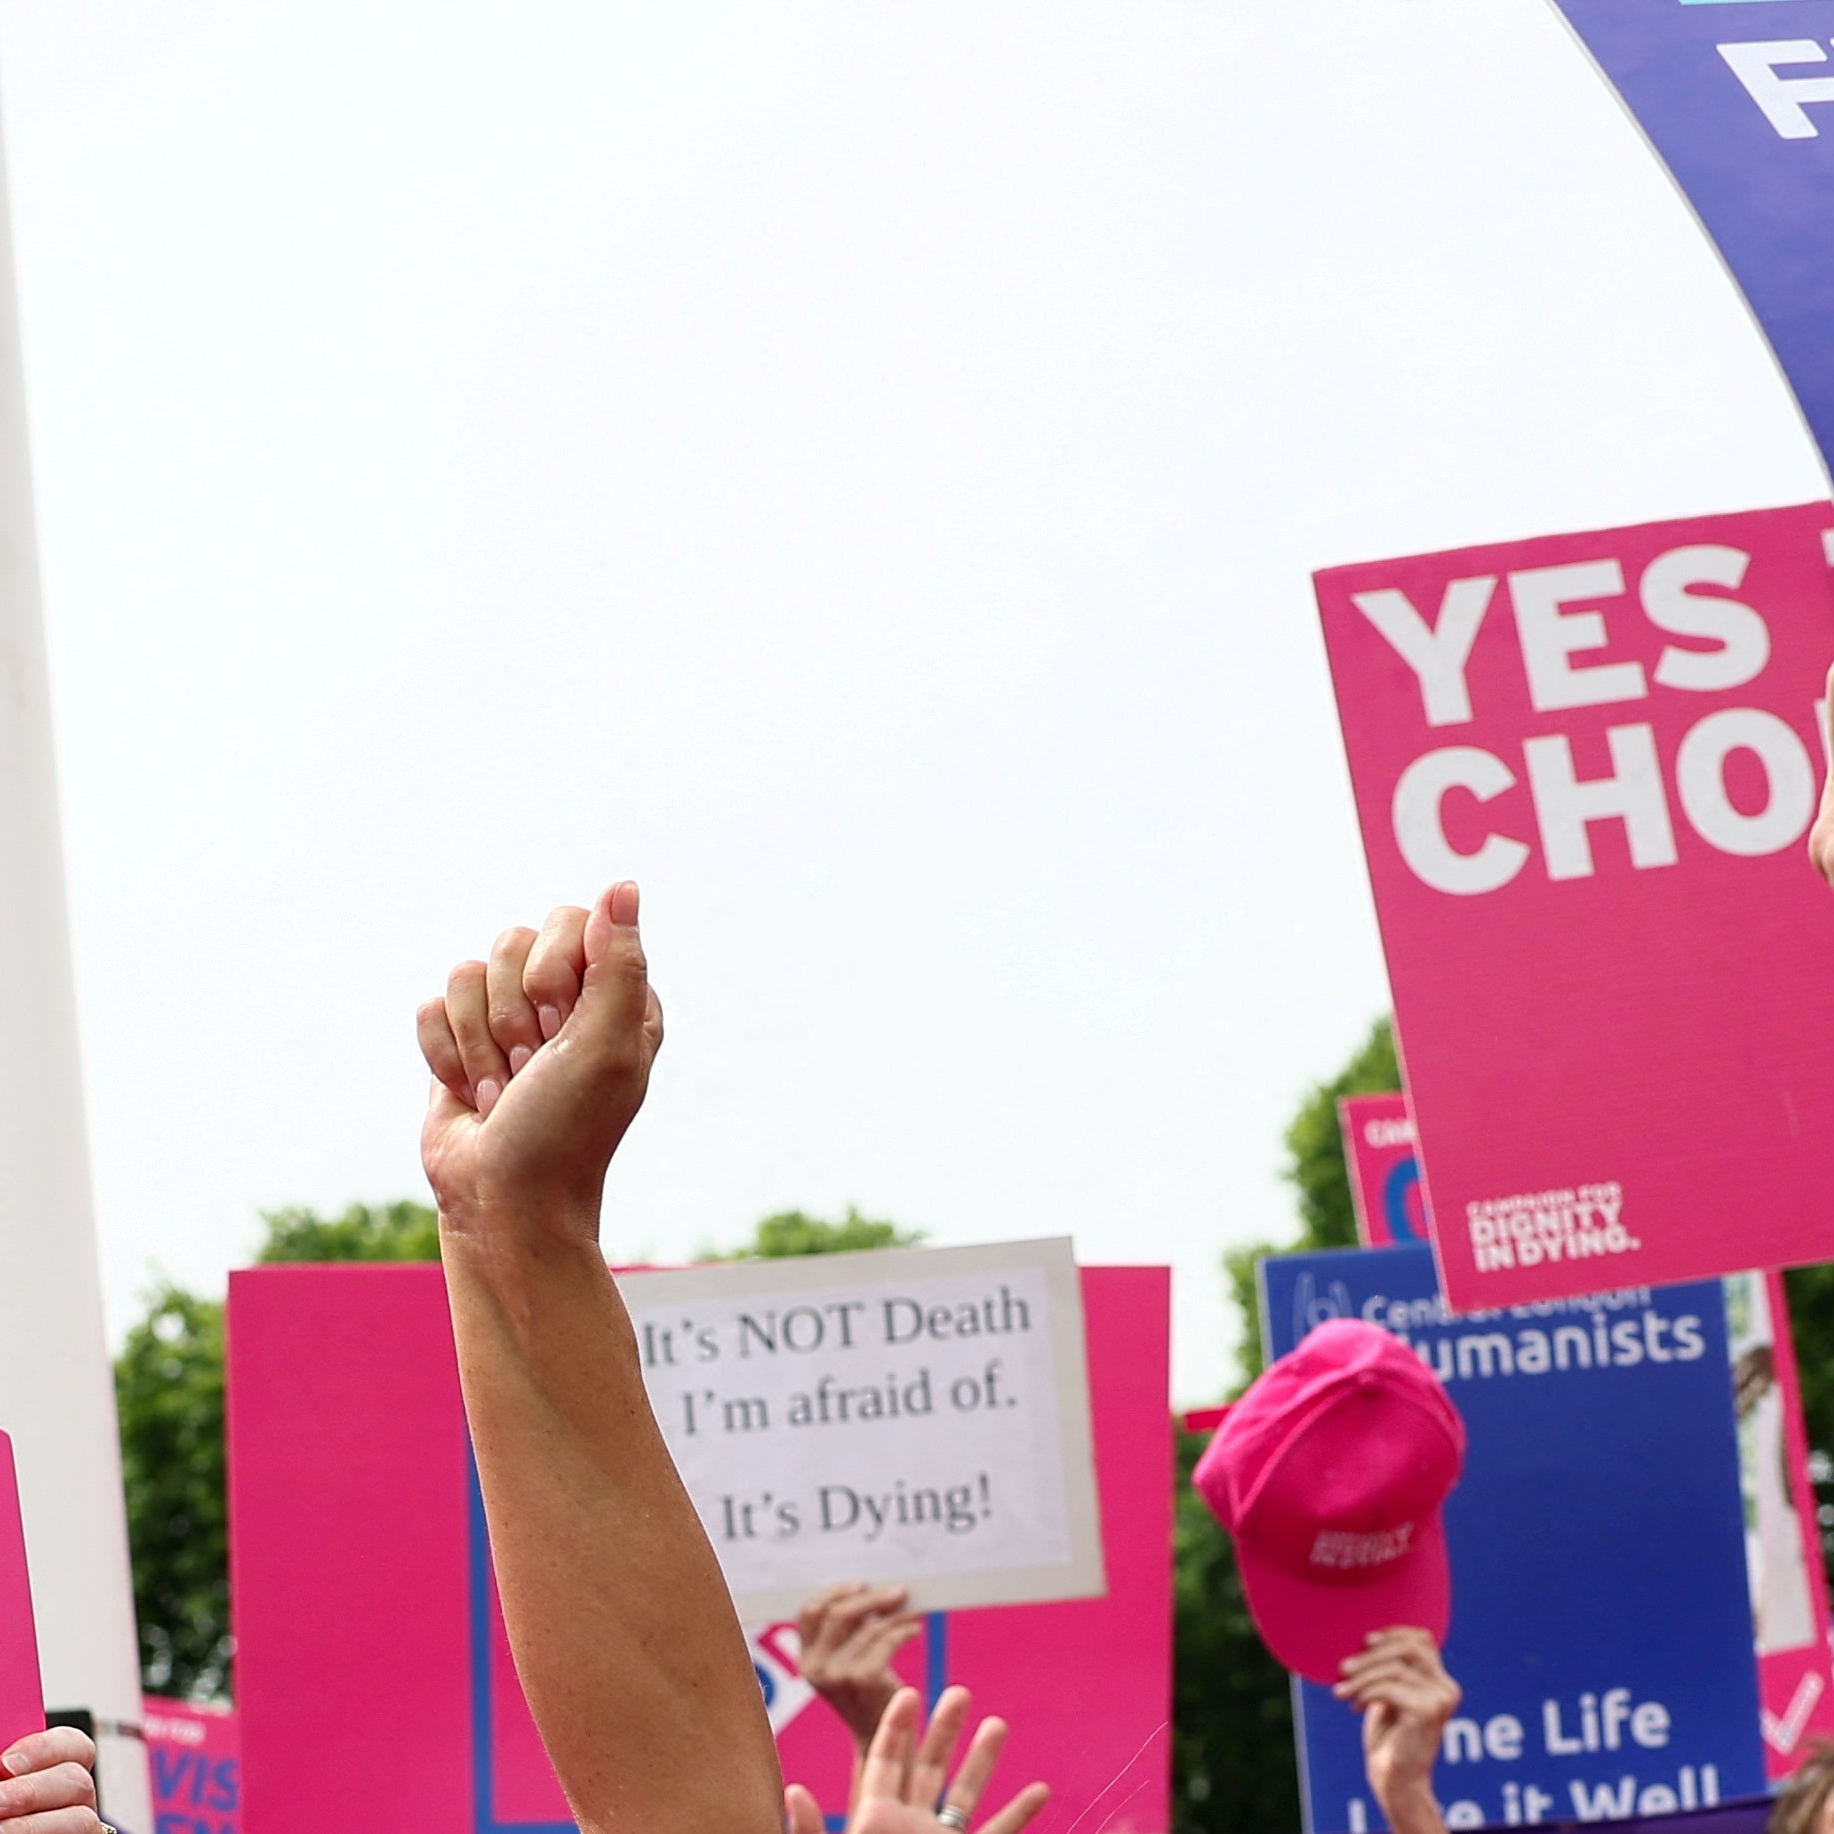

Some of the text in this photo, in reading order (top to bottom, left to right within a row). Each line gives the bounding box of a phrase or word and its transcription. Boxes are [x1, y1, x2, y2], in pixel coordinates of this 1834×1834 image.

[1353, 545, 1771, 727] YES
[1392, 706, 1830, 895] CHO
[1469, 1198, 1621, 1246] DIGNITY
[1474, 1222, 1642, 1273] IN DYING.
[643, 1285, 1032, 1368] It's NOT Death
[1395, 1310, 1706, 1384] umanists
[681, 1357, 1018, 1436] I'm afraid of.
[720, 1471, 993, 1543] It's Dying!
[1542, 1686, 1672, 1756] Life
